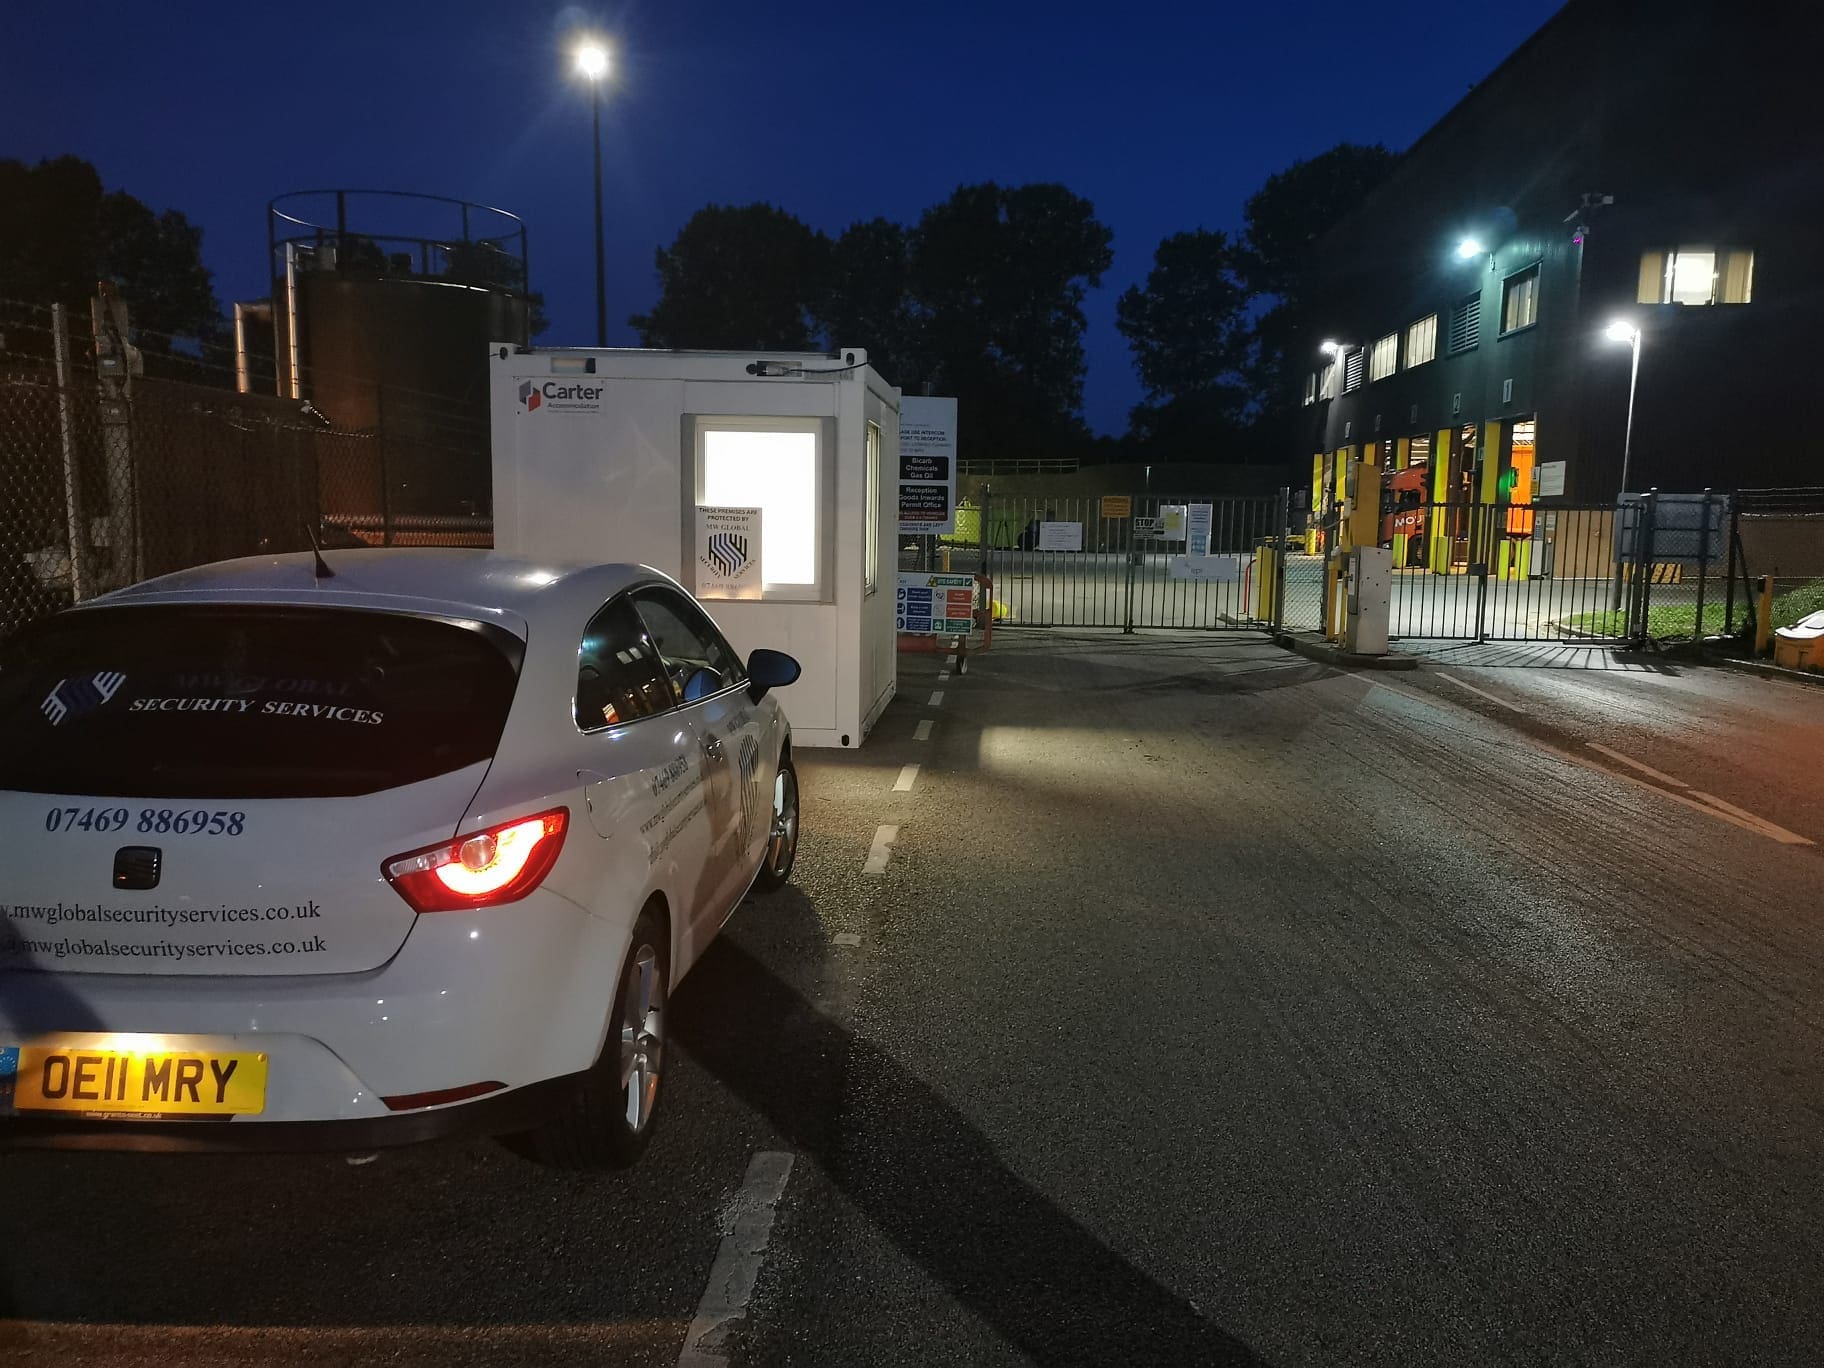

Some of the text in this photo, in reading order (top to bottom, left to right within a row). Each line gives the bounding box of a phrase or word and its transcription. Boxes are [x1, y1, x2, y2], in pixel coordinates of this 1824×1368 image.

[543, 382, 603, 400] Carter
[905, 464, 938, 472] Chemicals
[906, 487, 938, 495] Reception
[920, 494, 945, 502] Inwards
[901, 501, 942, 509] Permit Office
[1135, 518, 1155, 527] STOP
[128, 698, 385, 726] SECURITY SERVICES
[45, 807, 246, 837] 07469 886958
[141, 1058, 238, 1104] MRY
